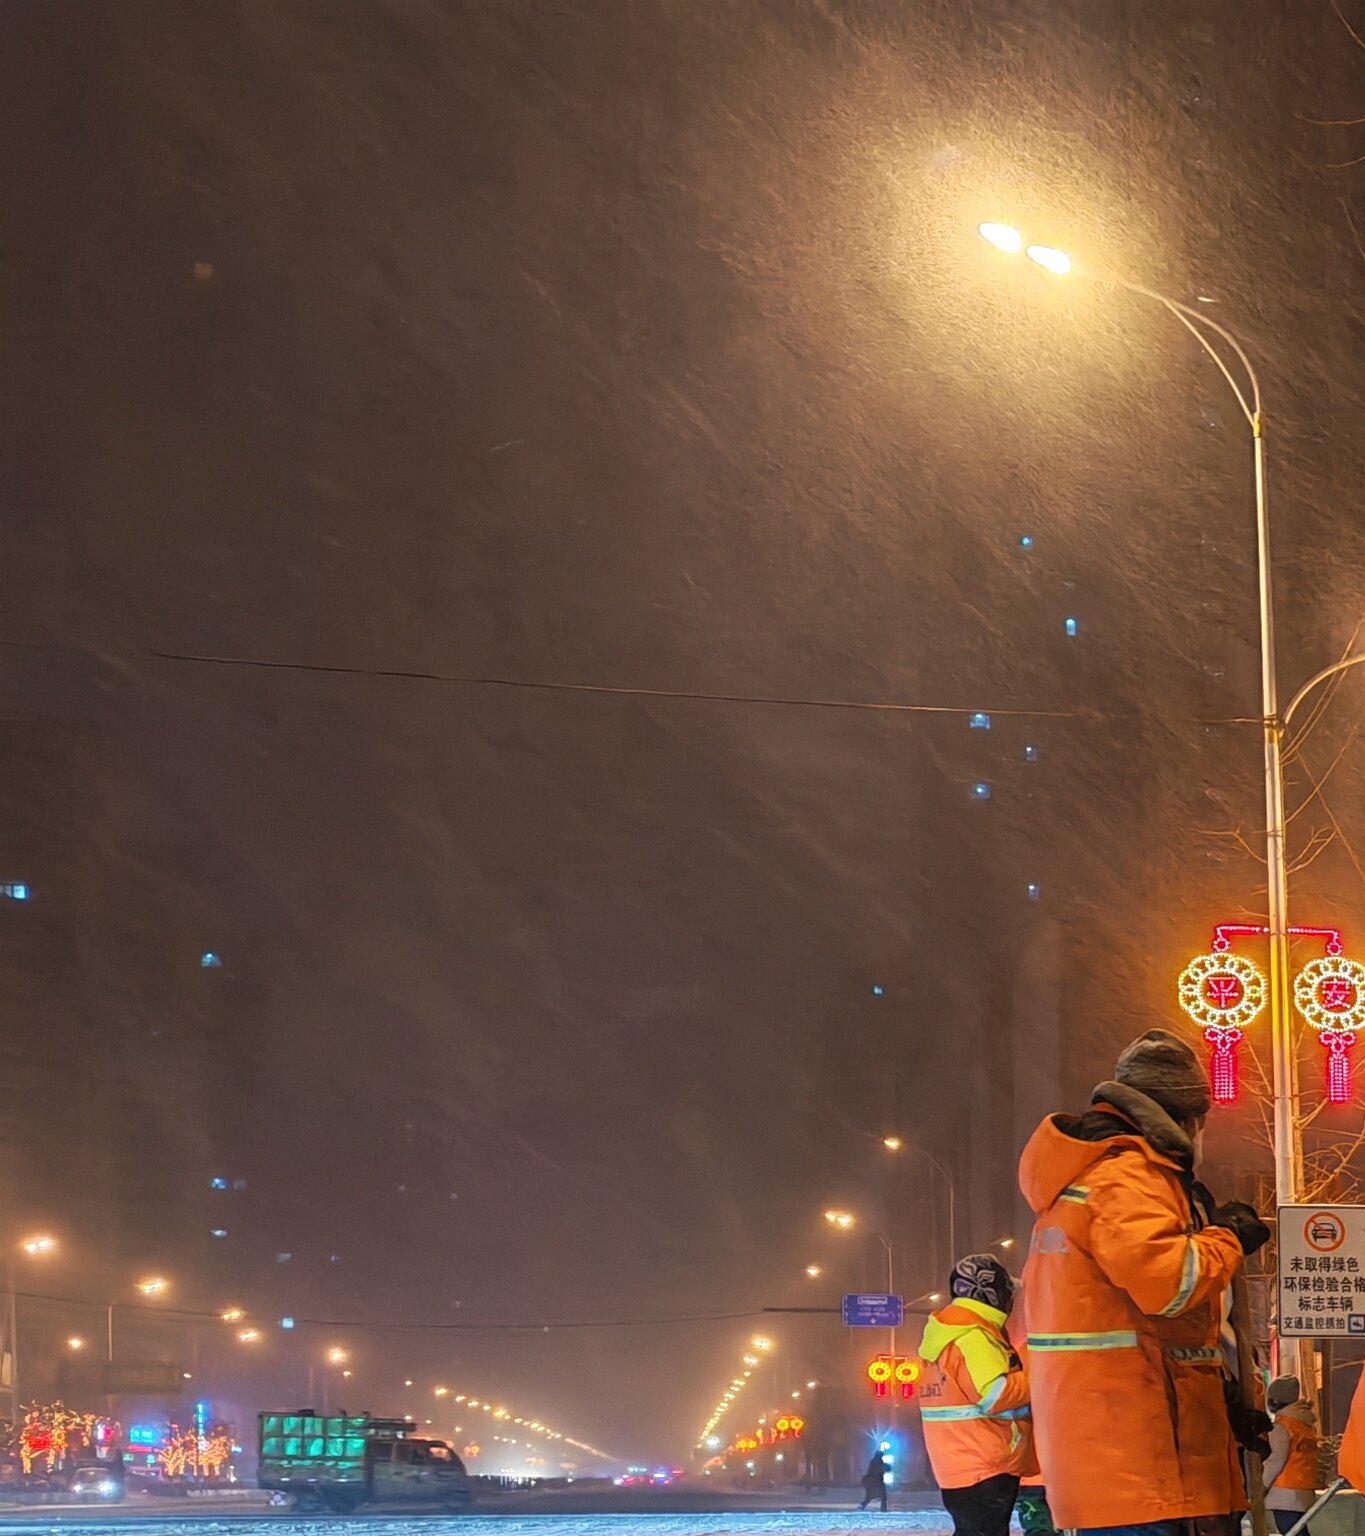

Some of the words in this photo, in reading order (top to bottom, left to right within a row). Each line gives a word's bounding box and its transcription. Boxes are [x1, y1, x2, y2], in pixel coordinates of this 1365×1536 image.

[1206, 975, 1239, 1009] 平
[1321, 978, 1351, 1010] 安
[1290, 1256, 1360, 1273] 未取得绿色
[1298, 1296, 1354, 1312] 标志车辆
[1283, 1317, 1346, 1330] 交通监控抓拍
